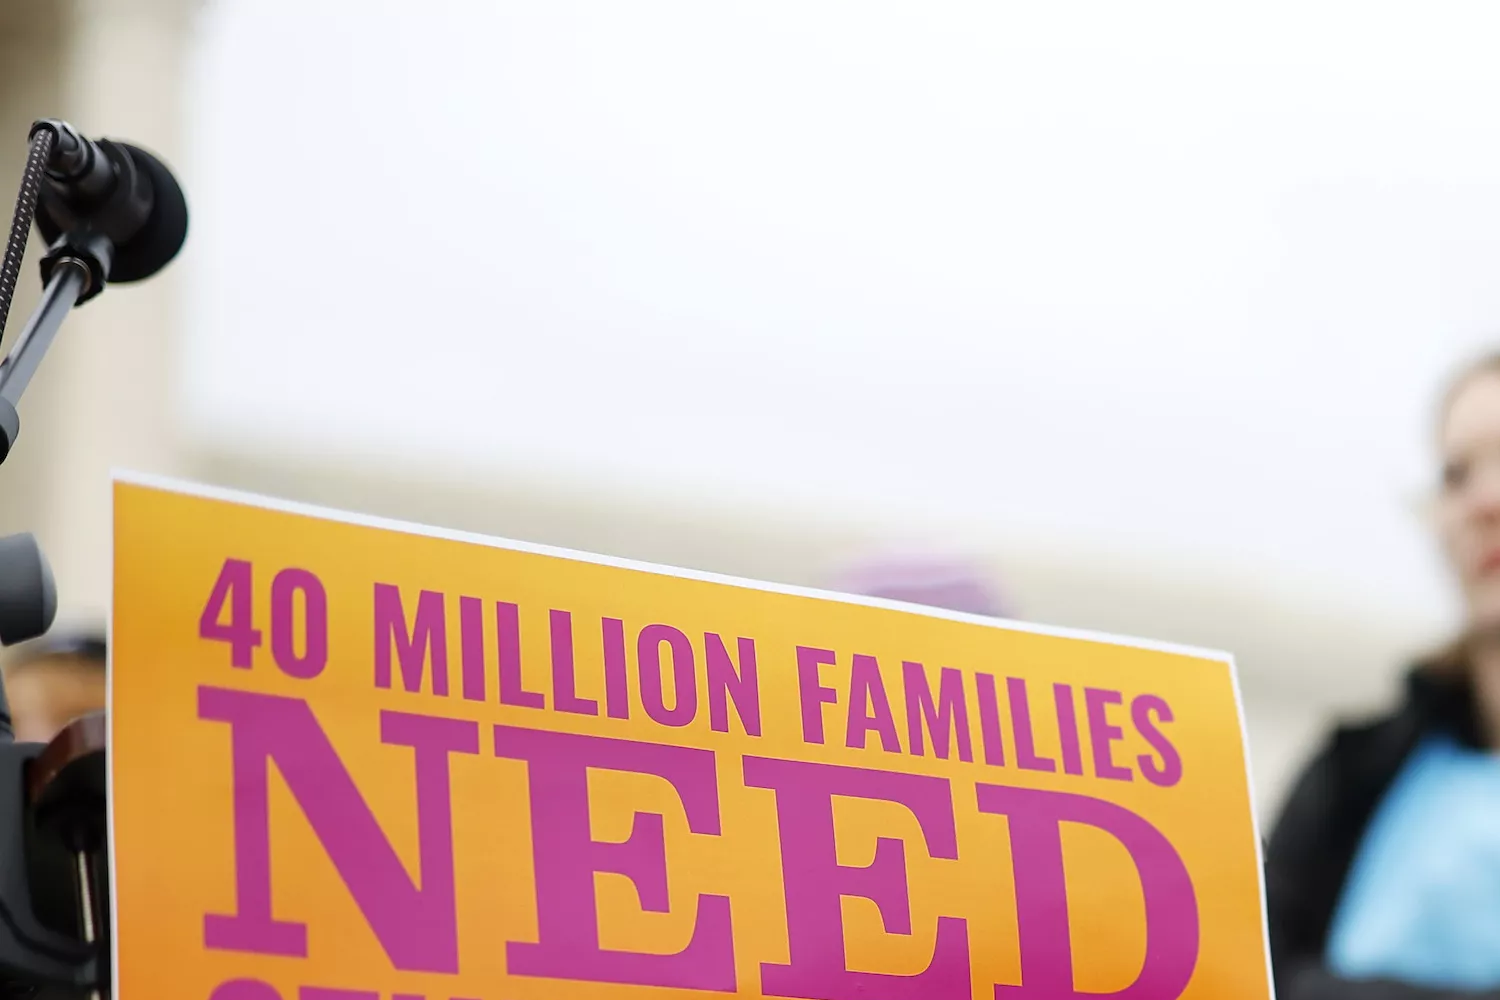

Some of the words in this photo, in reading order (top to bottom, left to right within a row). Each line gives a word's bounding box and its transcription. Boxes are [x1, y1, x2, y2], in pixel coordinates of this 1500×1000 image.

[199, 558, 327, 679] 40
[374, 583, 762, 737] MILLION
[796, 644, 1183, 787] FAMILIES
